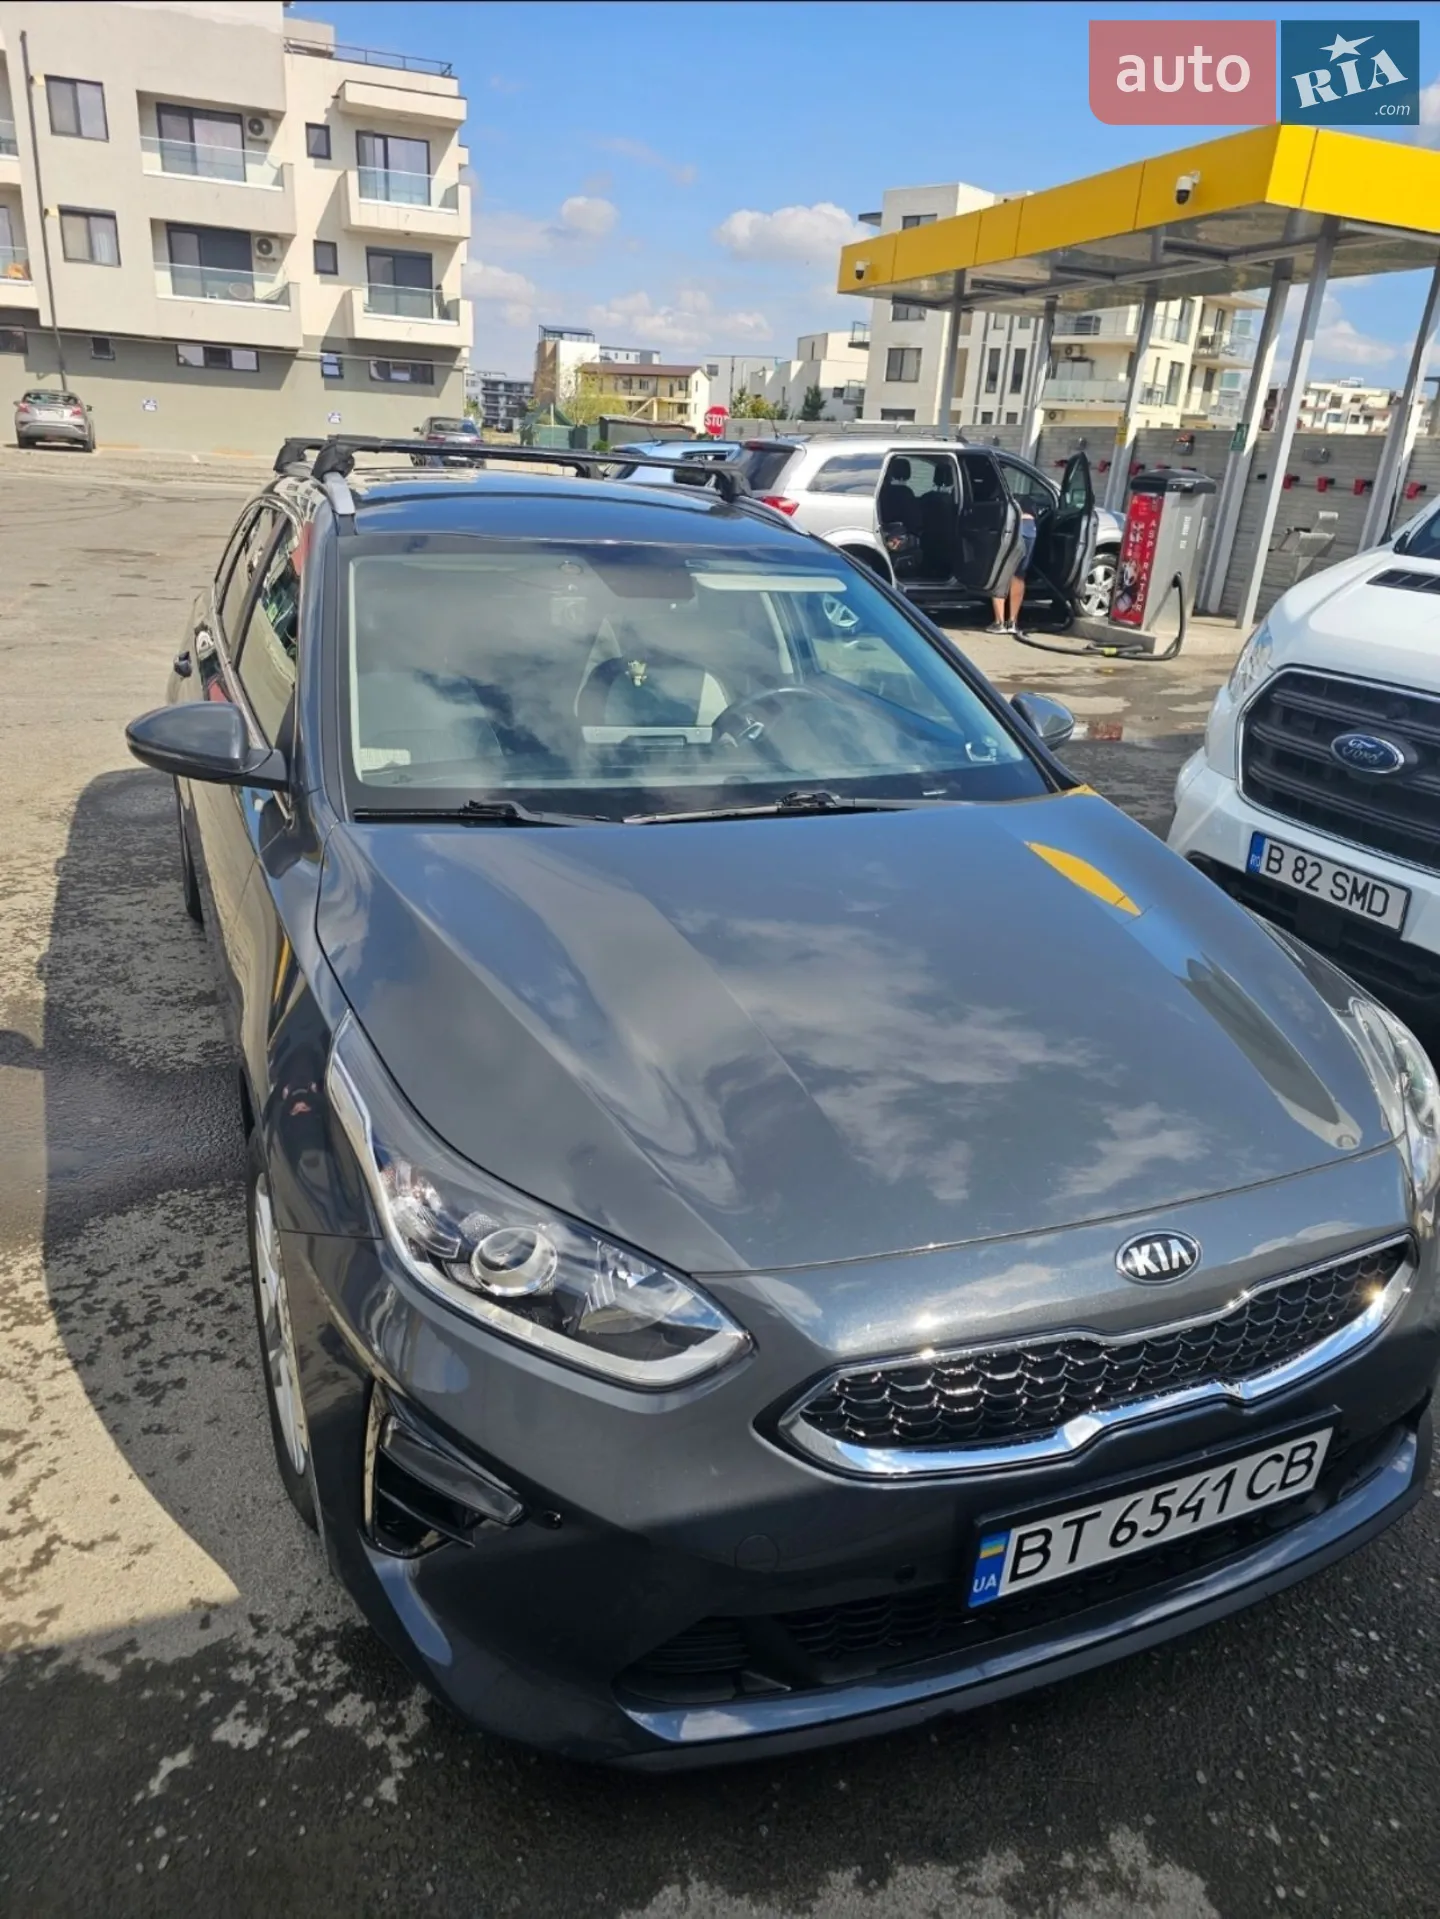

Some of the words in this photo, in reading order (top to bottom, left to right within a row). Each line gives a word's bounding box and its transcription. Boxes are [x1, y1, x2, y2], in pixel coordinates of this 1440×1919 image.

[1134, 519, 1158, 612] ASPIRATOR
[1341, 738, 1384, 765] Ford
[1265, 844, 1285, 875] B
[1291, 855, 1323, 892] 82
[1330, 871, 1390, 918] SMD
[1128, 1238, 1192, 1276] KIA
[1008, 1510, 1102, 1584] BT
[1108, 1466, 1239, 1549] 6541
[1246, 1440, 1318, 1501] CB
[973, 1574, 998, 1594] UA
